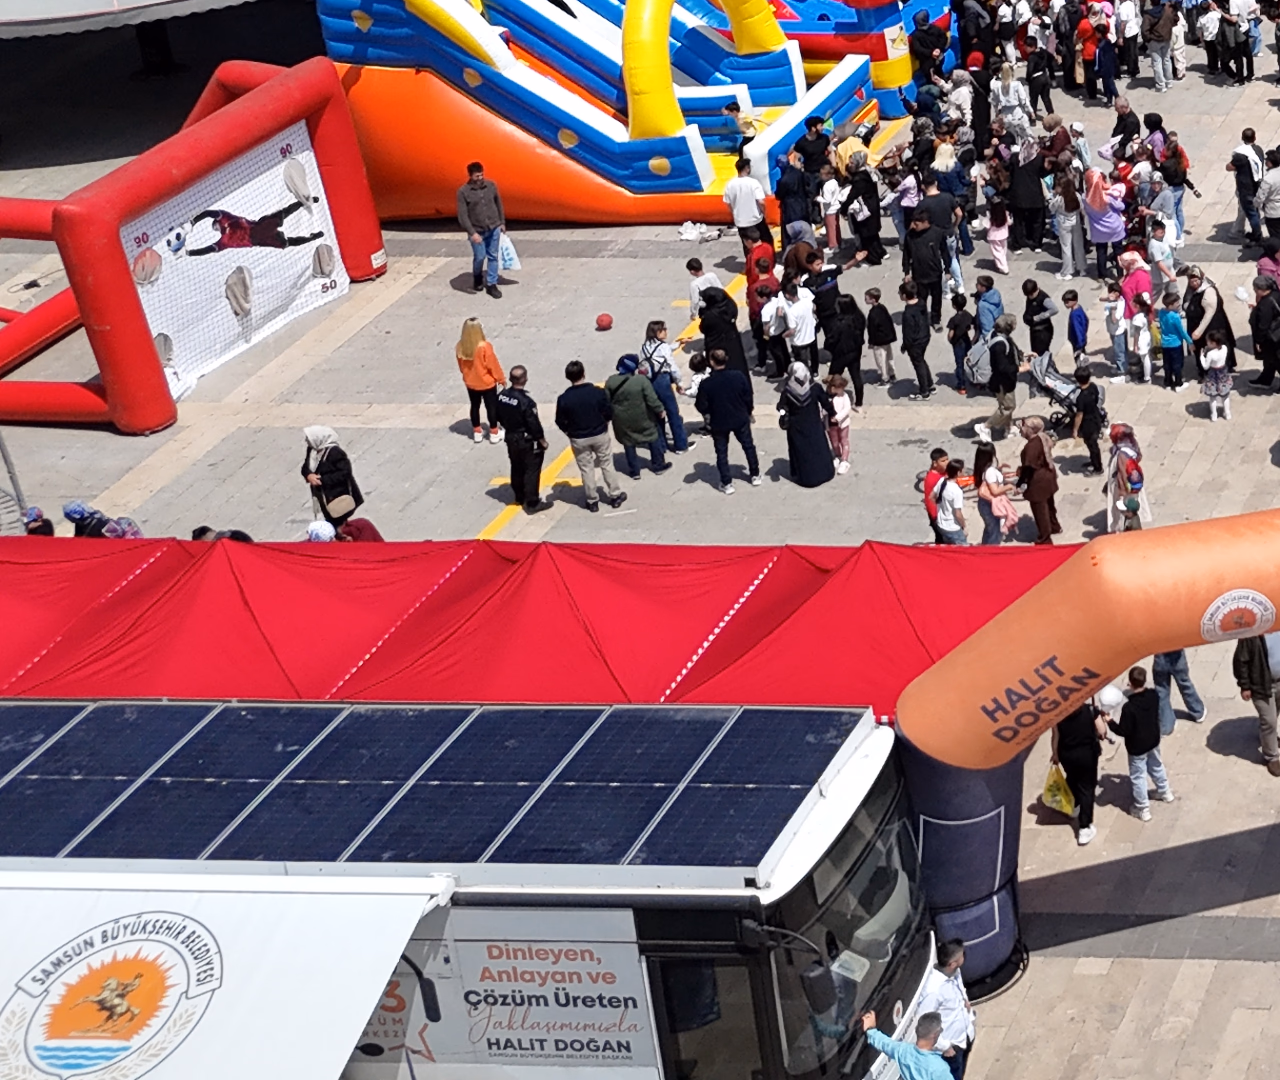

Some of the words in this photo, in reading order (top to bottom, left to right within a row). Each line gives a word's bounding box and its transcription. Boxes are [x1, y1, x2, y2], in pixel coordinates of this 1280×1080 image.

[280, 142, 293, 159] 90
[133, 231, 150, 248] 90
[320, 279, 338, 294] 50
[980, 654, 1065, 724] HALİT
[992, 666, 1102, 744] DOĞAN
[31, 935, 95, 986] SAMSUN
[101, 915, 187, 945] BÜYÜKŞEHİR
[182, 929, 219, 987] BELEDİYESİ
[486, 944, 602, 966] Dinleyen,
[479, 966, 583, 988] Anlayan
[587, 971, 617, 985] ve
[463, 989, 549, 1011] Çözüm
[554, 987, 639, 1010] Üreten
[467, 1004, 645, 1044] Yaklaşımımızla
[486, 1037, 547, 1052] HALİT
[554, 1036, 632, 1053] DOĞAN
